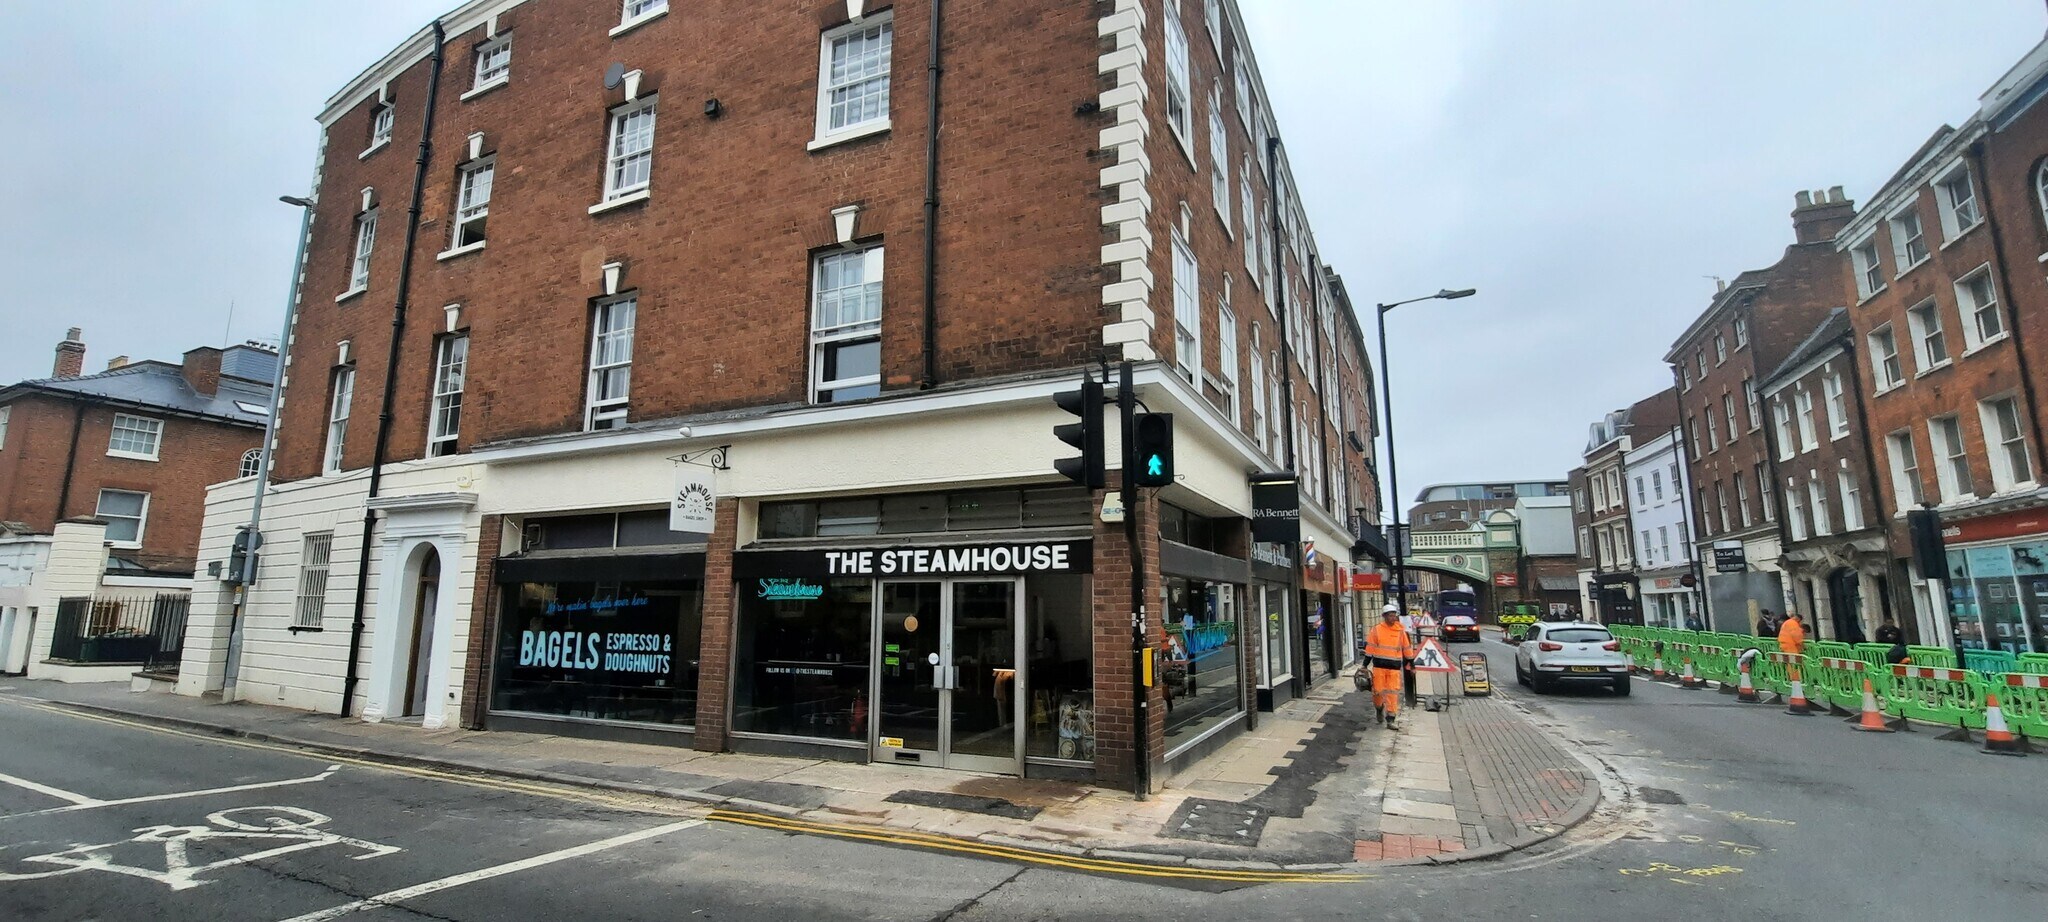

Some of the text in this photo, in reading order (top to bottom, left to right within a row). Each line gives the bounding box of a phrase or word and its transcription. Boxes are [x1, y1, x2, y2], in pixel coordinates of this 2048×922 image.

[678, 483, 713, 513] STEAMHOUSE
[1266, 508, 1299, 517] Bennett
[825, 545, 1069, 574] THE STEAMHOUSE
[520, 630, 671, 670] BAGELS ESPRESSO &
[604, 652, 670, 674] DOUGHNUTS
